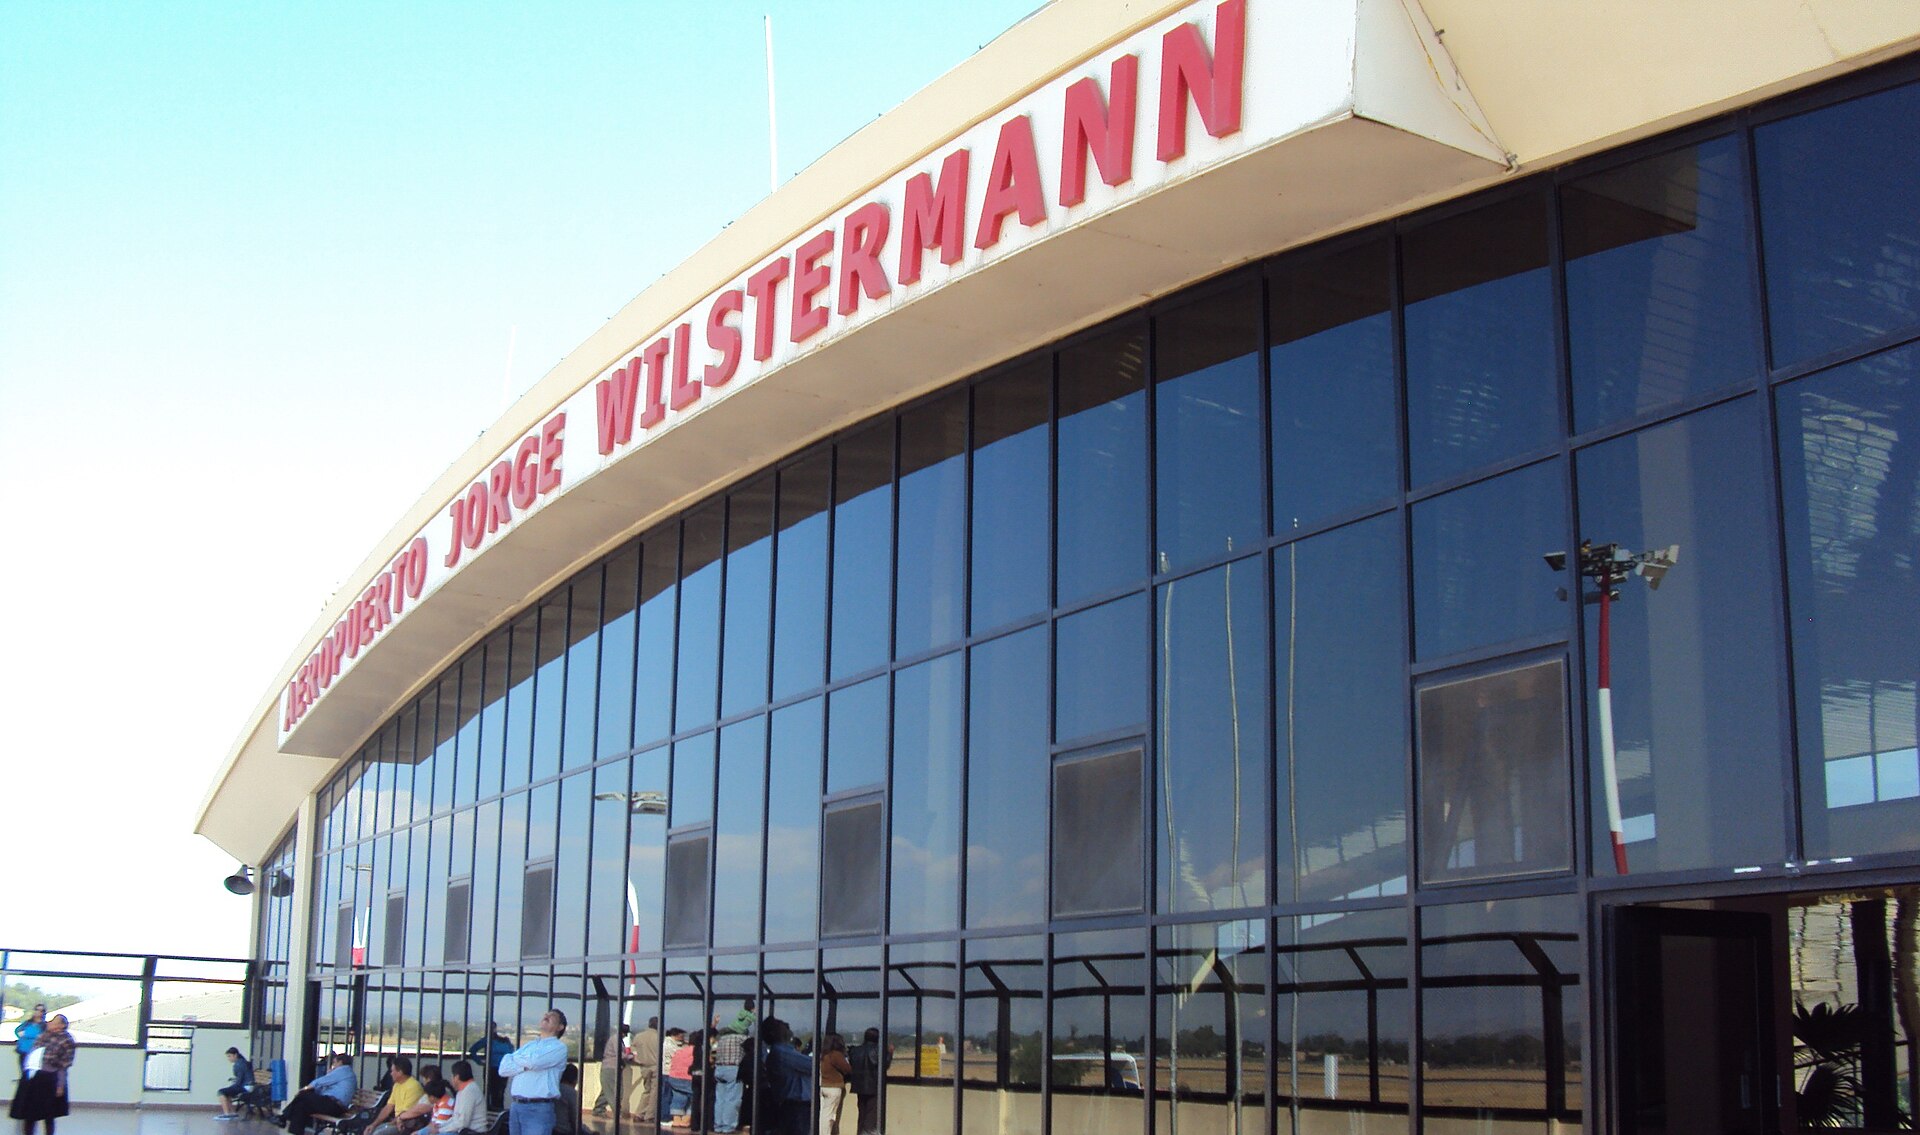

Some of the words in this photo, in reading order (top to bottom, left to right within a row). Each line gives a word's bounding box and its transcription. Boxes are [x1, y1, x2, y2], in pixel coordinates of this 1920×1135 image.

[283, 537, 428, 732] AEROPUERTO
[444, 412, 567, 568] JORGE
[596, 0, 1246, 456] WILSTERMANN
